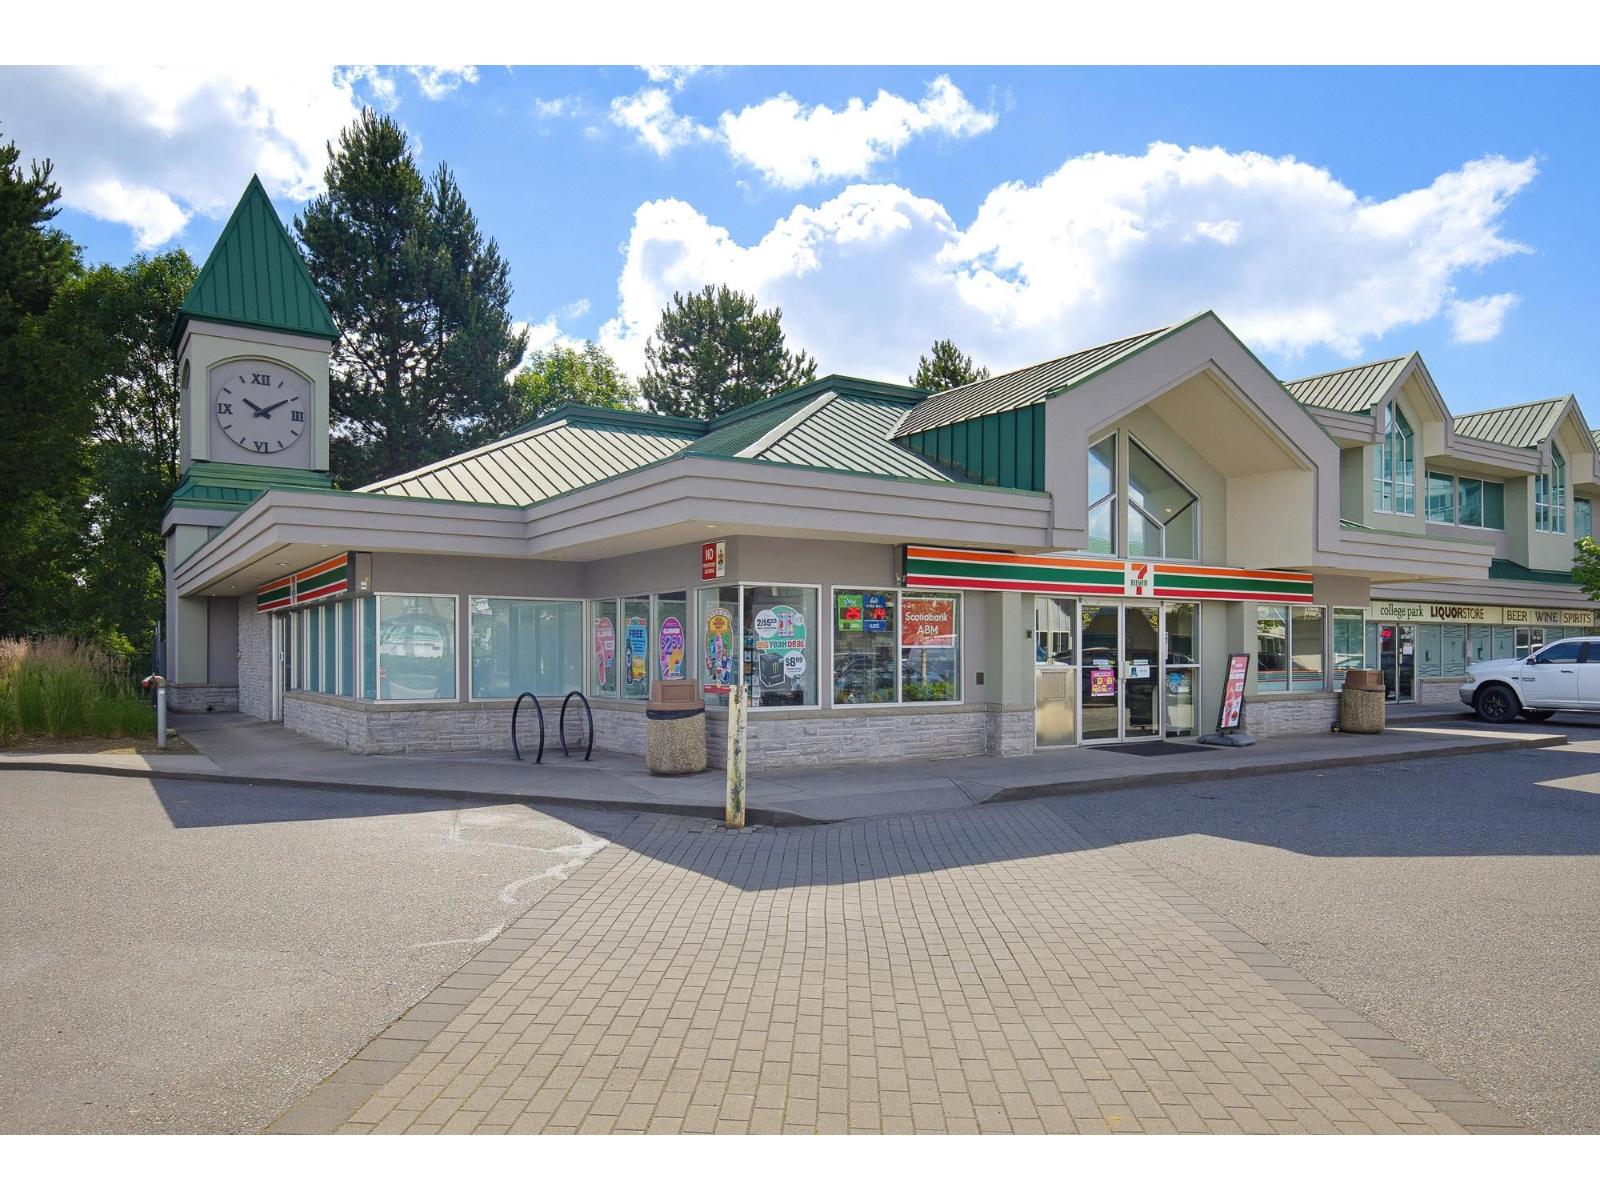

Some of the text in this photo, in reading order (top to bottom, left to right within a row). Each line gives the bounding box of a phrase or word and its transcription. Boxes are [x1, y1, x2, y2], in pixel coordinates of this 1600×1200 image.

[251, 374, 270, 386] XII
[218, 403, 233, 414] IX
[291, 411, 304, 422] III
[253, 441, 269, 453] VI
[705, 548, 714, 561] NO
[905, 612, 948, 622] Scotiabank
[1380, 603, 1406, 619] college
[1407, 605, 1424, 620] park
[1507, 611, 1591, 623] BEER WINE SPIRITS
[629, 629, 644, 639] FREE
[917, 625, 938, 635] ABM
